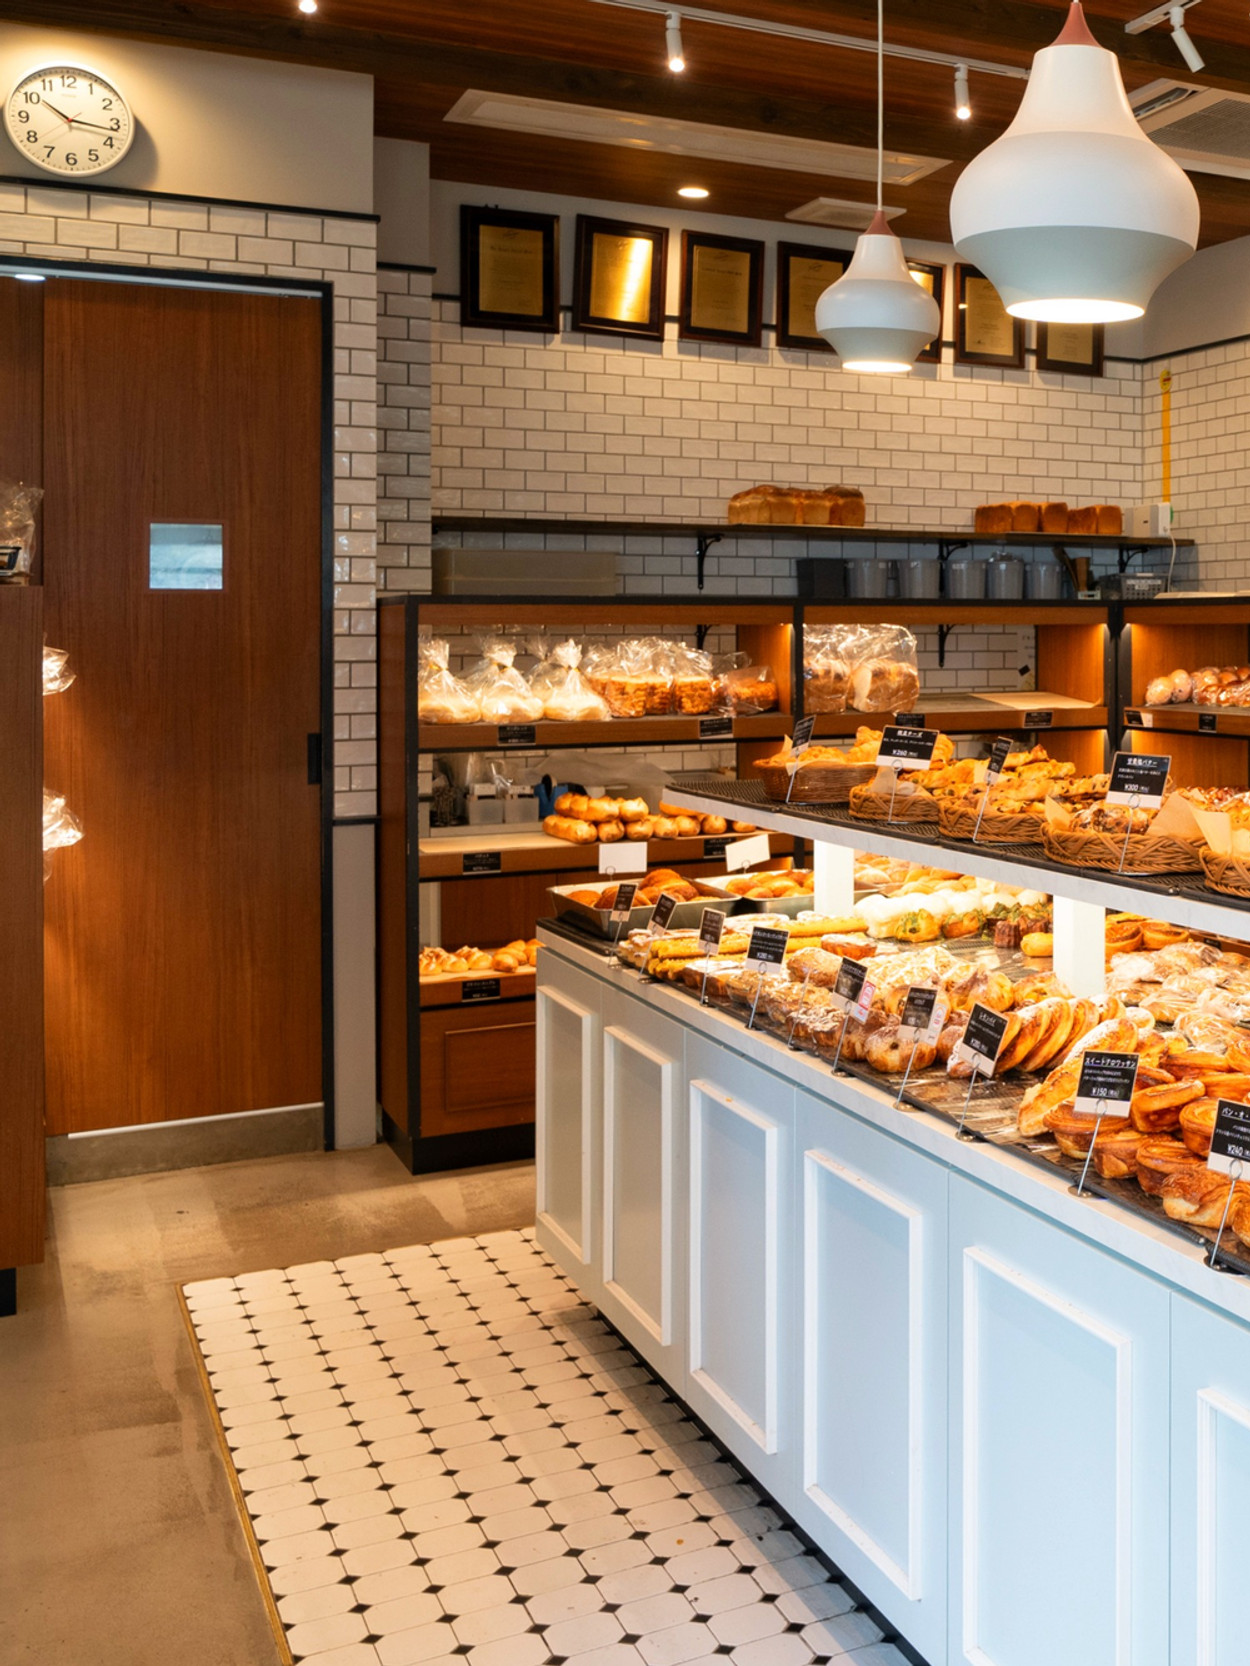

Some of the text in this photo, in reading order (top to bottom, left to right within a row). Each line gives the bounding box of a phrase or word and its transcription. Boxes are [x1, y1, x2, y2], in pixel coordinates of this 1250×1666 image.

[41, 78, 53, 92] 11
[60, 75, 77, 88] 12
[88, 83, 94, 95] 1
[23, 91, 41, 104] 10
[102, 98, 113, 110] 2
[18, 110, 29, 123] 9
[110, 118, 121, 131] 3
[26, 130, 38, 143] 8
[103, 136, 114, 149] 4
[43, 145, 55, 158] 7
[88, 149, 99, 162] 5
[65, 153, 78, 165] 6
